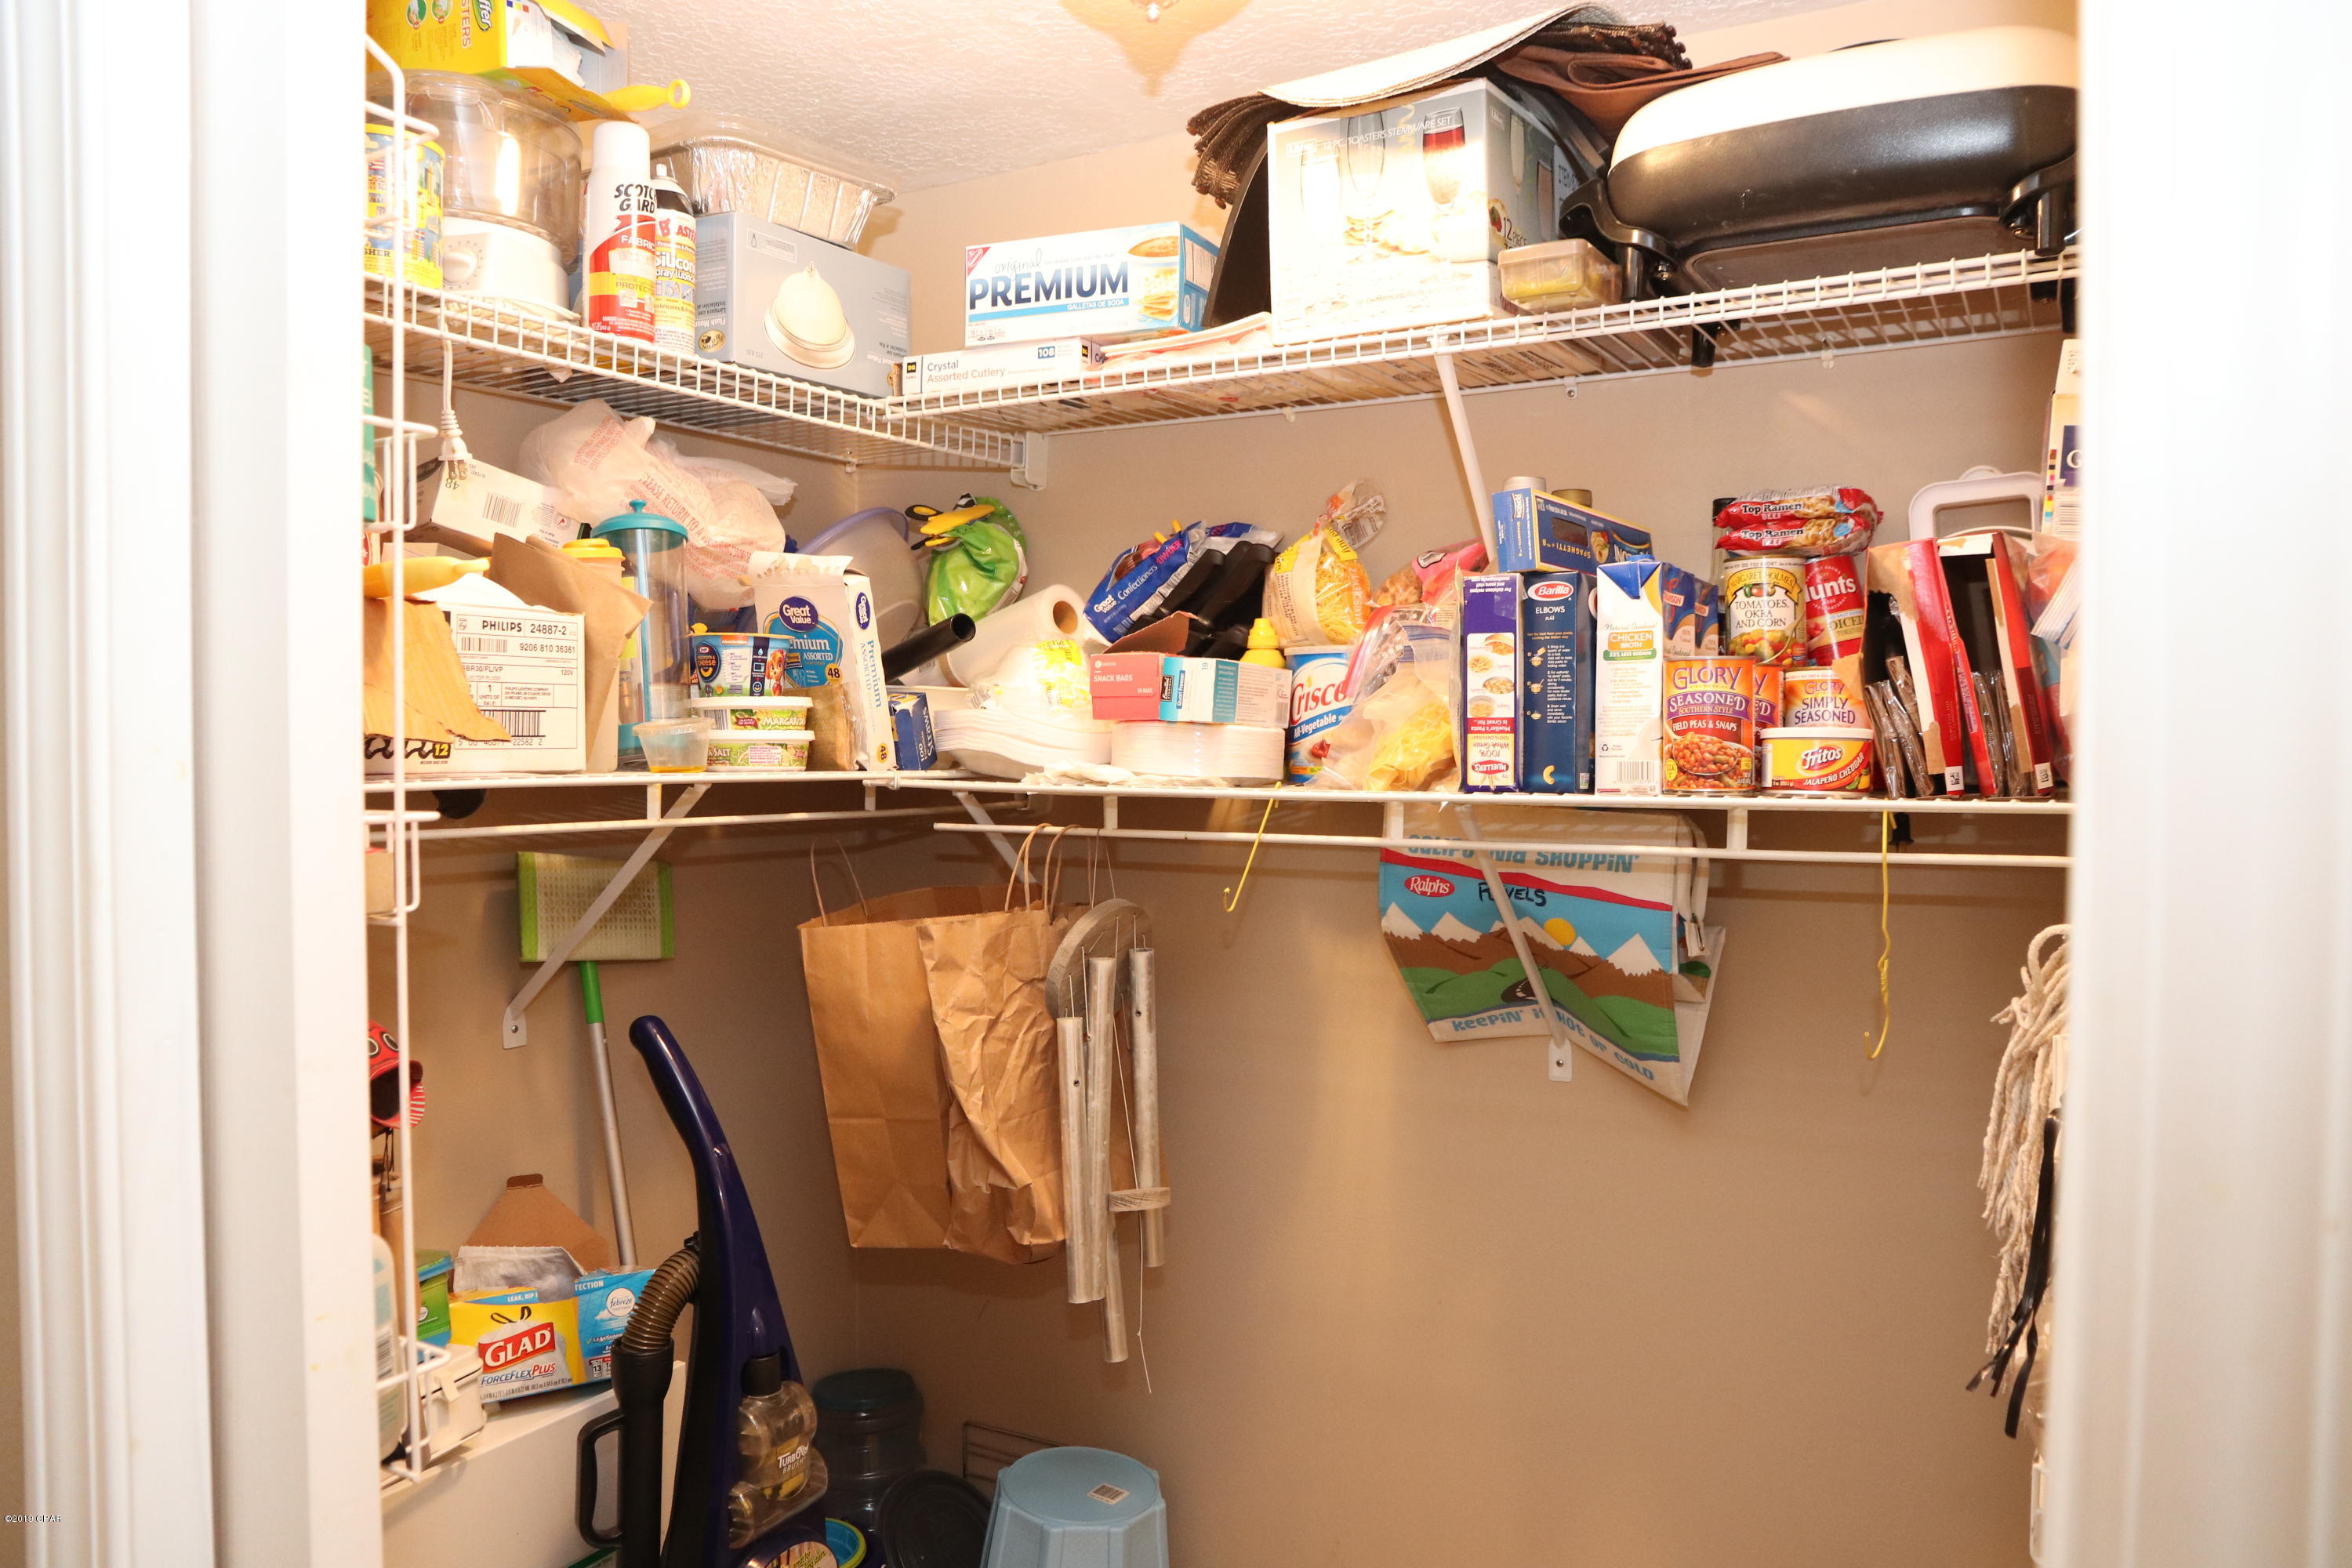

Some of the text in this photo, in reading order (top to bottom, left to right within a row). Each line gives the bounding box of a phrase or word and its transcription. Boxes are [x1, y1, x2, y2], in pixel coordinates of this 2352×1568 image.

[1436, 116, 1451, 127] SET
[969, 261, 1129, 310] PREMIUM
[1097, 299, 1106, 308] DE
[1038, 347, 1055, 358] 108
[927, 360, 960, 372] Crystal
[927, 370, 969, 383] Assorted
[971, 368, 1006, 379] Cutlery
[660, 493, 691, 524] RETURN
[687, 517, 699, 532] TO
[1741, 503, 1802, 515] Top Ramen
[1761, 512, 1783, 521] BEEF
[1741, 528, 1803, 541] Top Ramen
[1555, 543, 1591, 558] SPAGHETTI
[1116, 564, 1159, 601] Confectioners
[1537, 585, 1570, 596] Barilla
[782, 604, 811, 617] Great
[1093, 594, 1116, 613] Great
[1535, 605, 1566, 615] ELBOWS
[790, 615, 811, 625] Value
[1735, 618, 1787, 629] AND CORN
[482, 620, 568, 636] PHILIPS 24887-2
[1610, 632, 1653, 643] CHICKEN
[519, 643, 538, 652] 9206
[555, 644, 576, 654] 36361
[804, 652, 833, 662] ASSORTED
[827, 668, 841, 679] 48
[867, 639, 883, 709] Premium
[1673, 666, 1743, 690] GLORY
[1804, 681, 1846, 695] GLORY
[1669, 692, 1746, 713] SEASONED
[1802, 696, 1849, 711] SIMPLY
[1678, 705, 1734, 715] SOUTHERN STYLE
[1795, 710, 1856, 725] SEASONED
[922, 706, 935, 757] Straws
[1294, 713, 1337, 739] All-Vegetable
[1672, 719, 1738, 731] FIELD PEAS & SNAPS
[512, 738, 534, 746] 22582
[538, 737, 543, 746] 2
[434, 743, 449, 757] 12
[879, 744, 887, 760] 48
[1479, 749, 1501, 758] 100%
[1802, 747, 1843, 770] Fritos
[1838, 752, 1865, 779] CHEDDAR
[1473, 762, 1508, 772] MUELLER'S
[1410, 875, 1451, 895] Ralphs
[1478, 880, 1548, 907] RVELS
[610, 1295, 633, 1308] febreze
[485, 1329, 551, 1367] GLAD
[593, 1364, 602, 1373] 13
[778, 1444, 808, 1468] TURBO
[782, 1457, 804, 1475] BRUSH
